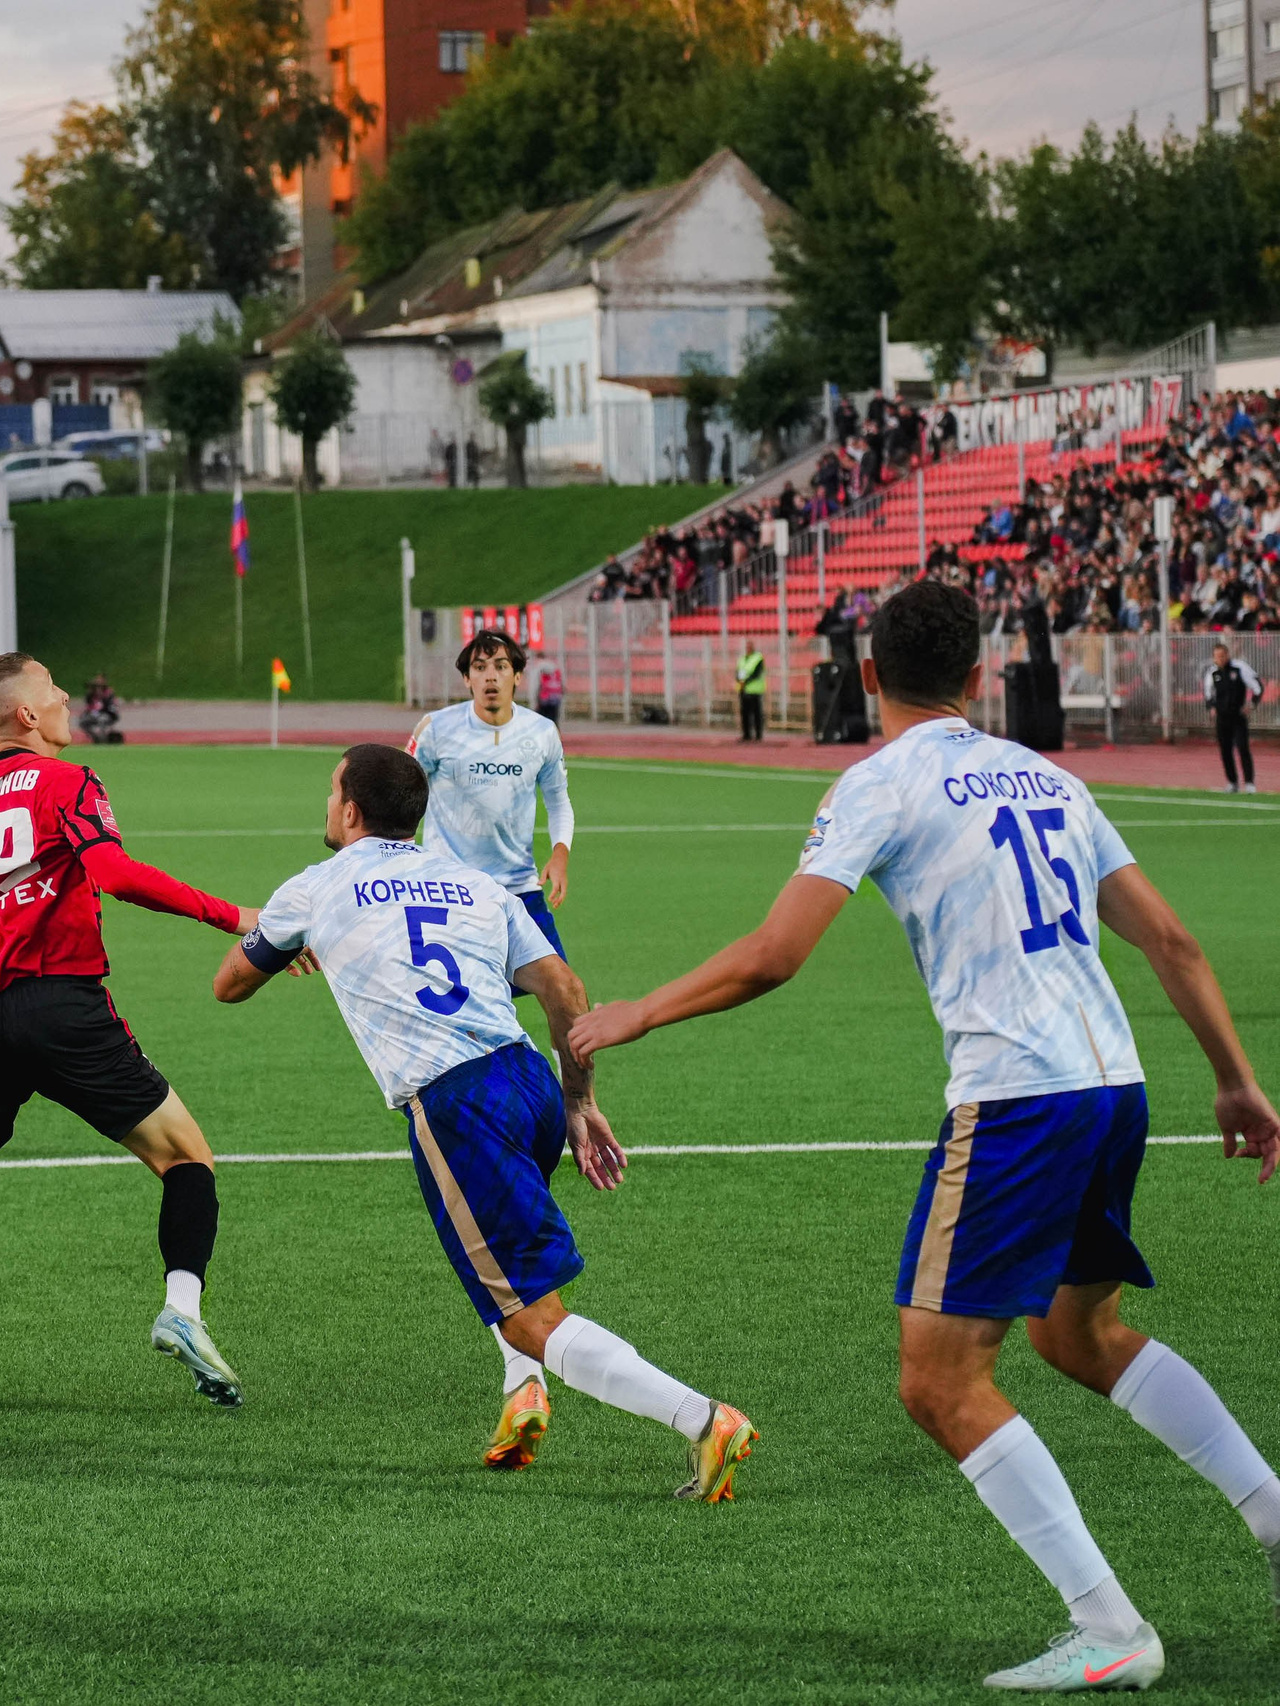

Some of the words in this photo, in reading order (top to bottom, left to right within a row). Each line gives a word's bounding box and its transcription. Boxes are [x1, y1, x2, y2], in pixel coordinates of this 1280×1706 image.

[944, 770, 1072, 807] СОКОЛОВ
[353, 878, 474, 908] КОРНЕЕВ
[988, 805, 1091, 954] 15
[404, 906, 470, 1016] 5
